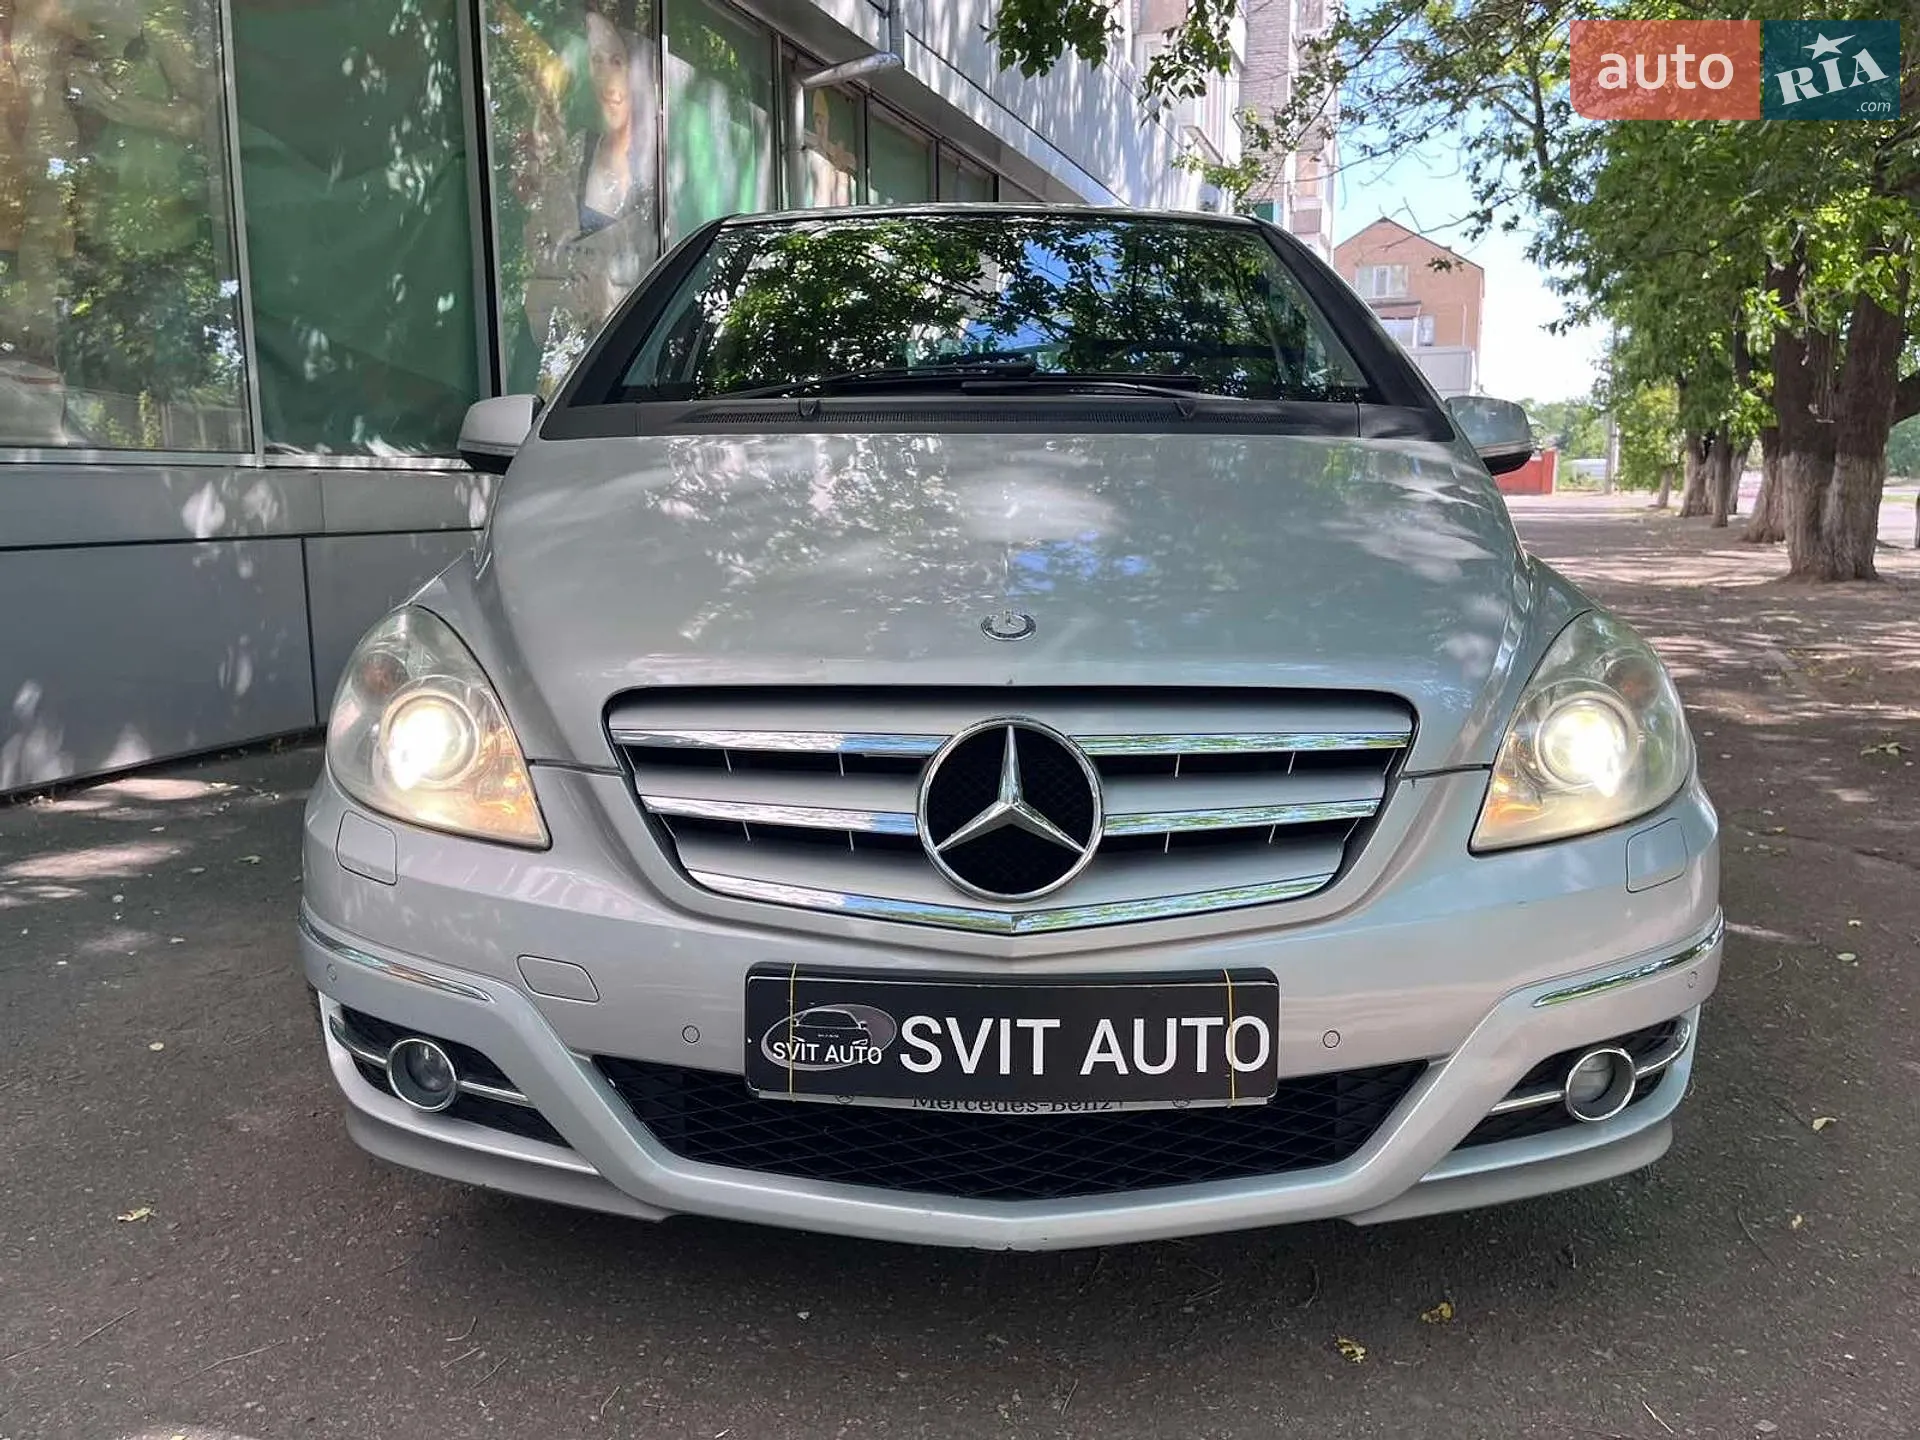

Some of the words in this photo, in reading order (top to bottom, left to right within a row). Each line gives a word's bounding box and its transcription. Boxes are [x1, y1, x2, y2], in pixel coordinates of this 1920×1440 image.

[773, 1041, 820, 1061] SVIT
[824, 1045, 882, 1064] AUTO
[900, 1015, 1061, 1075] SVIT
[1079, 1017, 1271, 1075] AUTO
